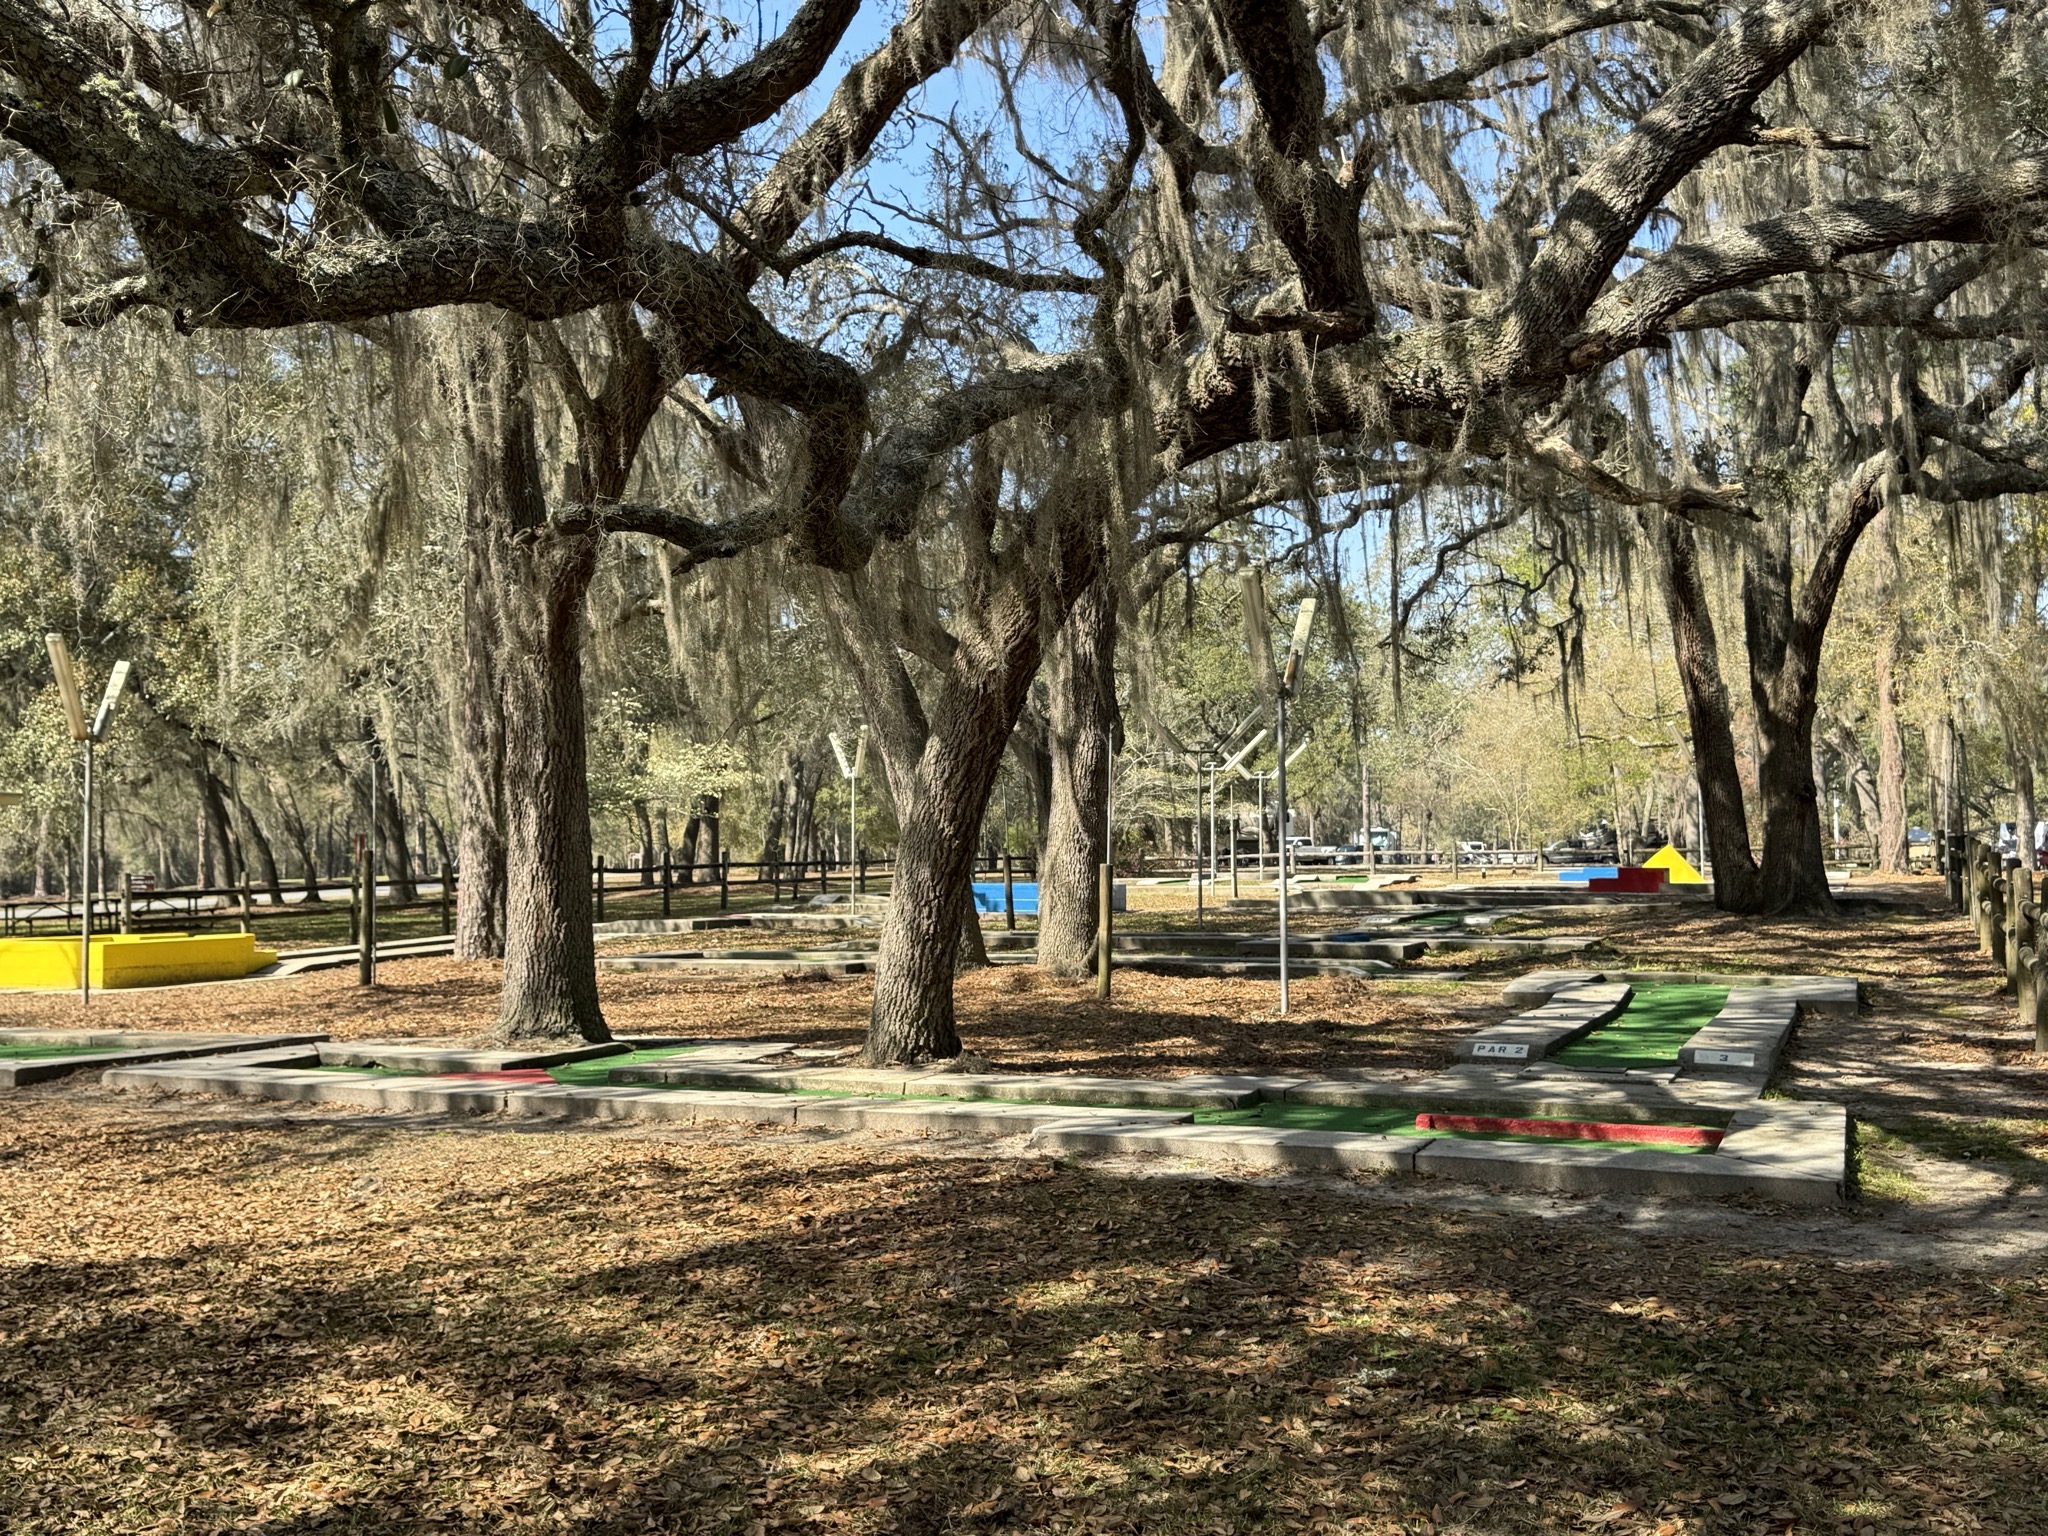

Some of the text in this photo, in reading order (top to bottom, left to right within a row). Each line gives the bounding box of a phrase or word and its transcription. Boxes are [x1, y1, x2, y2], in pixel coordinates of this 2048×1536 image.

[1476, 1044, 1524, 1054] PAR 2
[1719, 1054, 1729, 1062] 3
